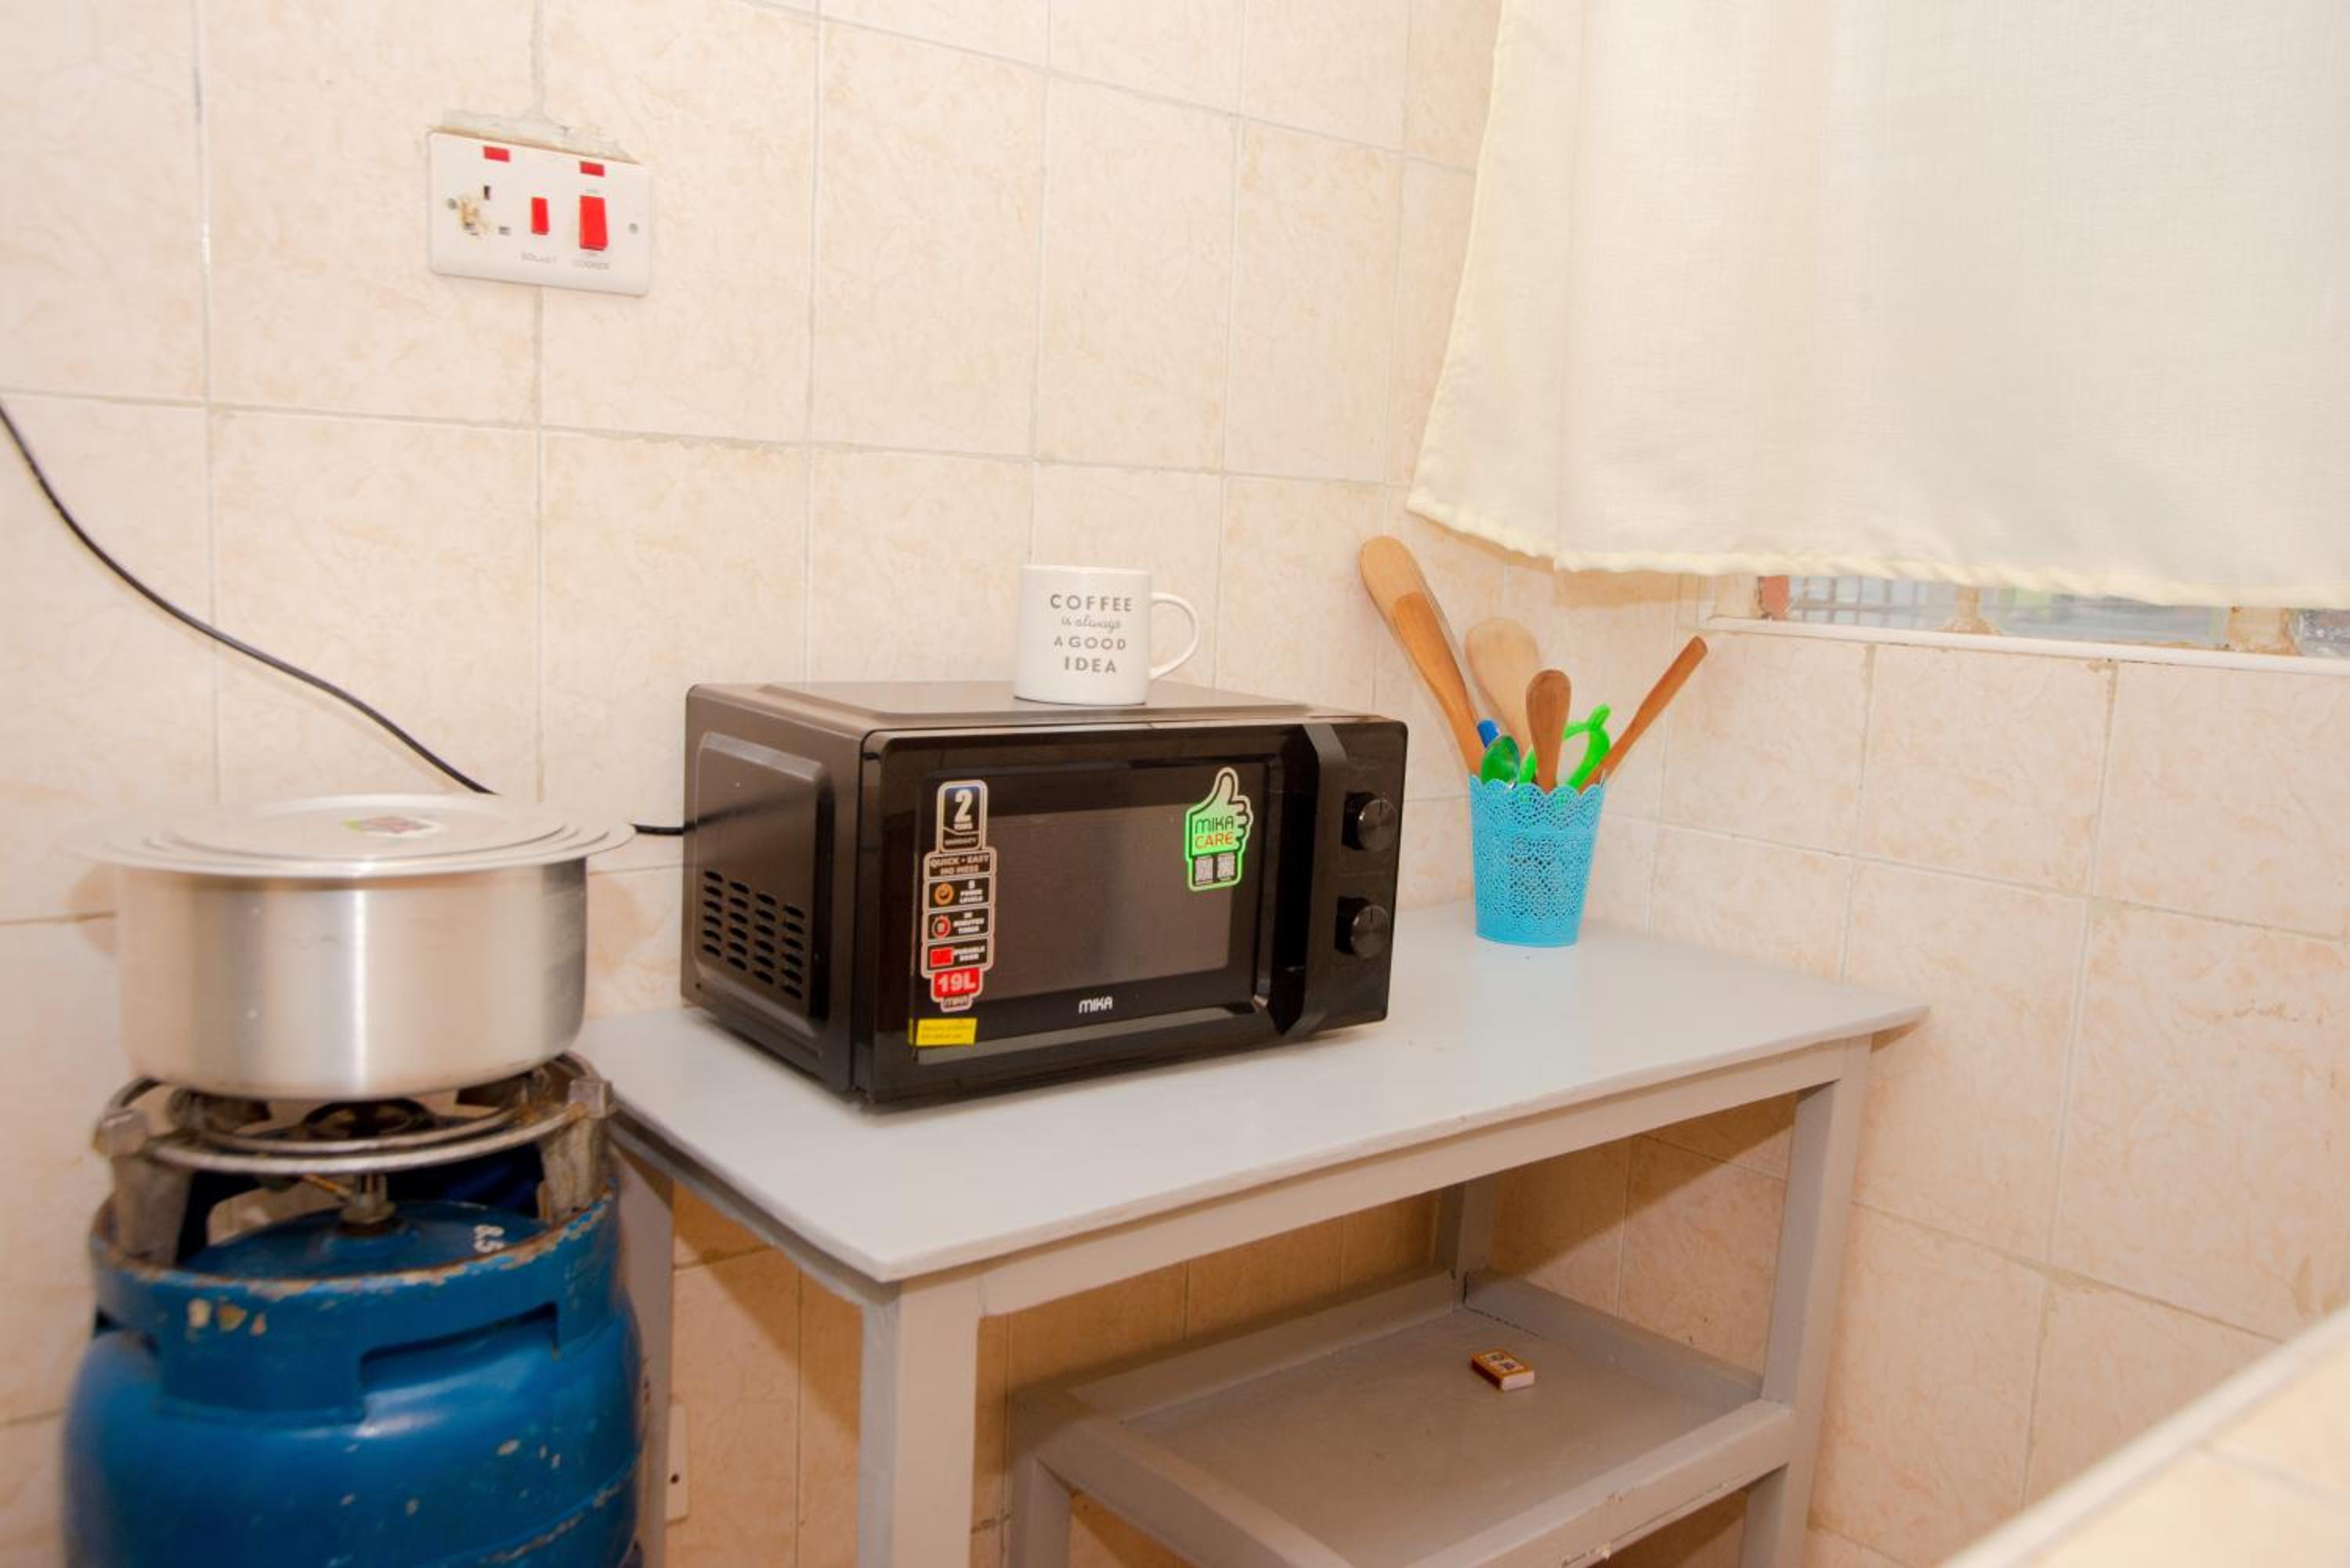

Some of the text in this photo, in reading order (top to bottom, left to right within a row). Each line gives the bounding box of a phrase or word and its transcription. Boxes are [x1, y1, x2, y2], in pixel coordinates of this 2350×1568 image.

[1050, 594, 1132, 612] COFFEE
[1061, 615, 1122, 633] is always
[1054, 636, 1126, 650] A GOOD
[1065, 656, 1116, 674] IDEA
[954, 789, 973, 822] 2
[1195, 815, 1235, 834] MIKA
[1195, 832, 1235, 849] CARE
[937, 971, 977, 993] 19L
[1079, 996, 1113, 1013] MIKA
